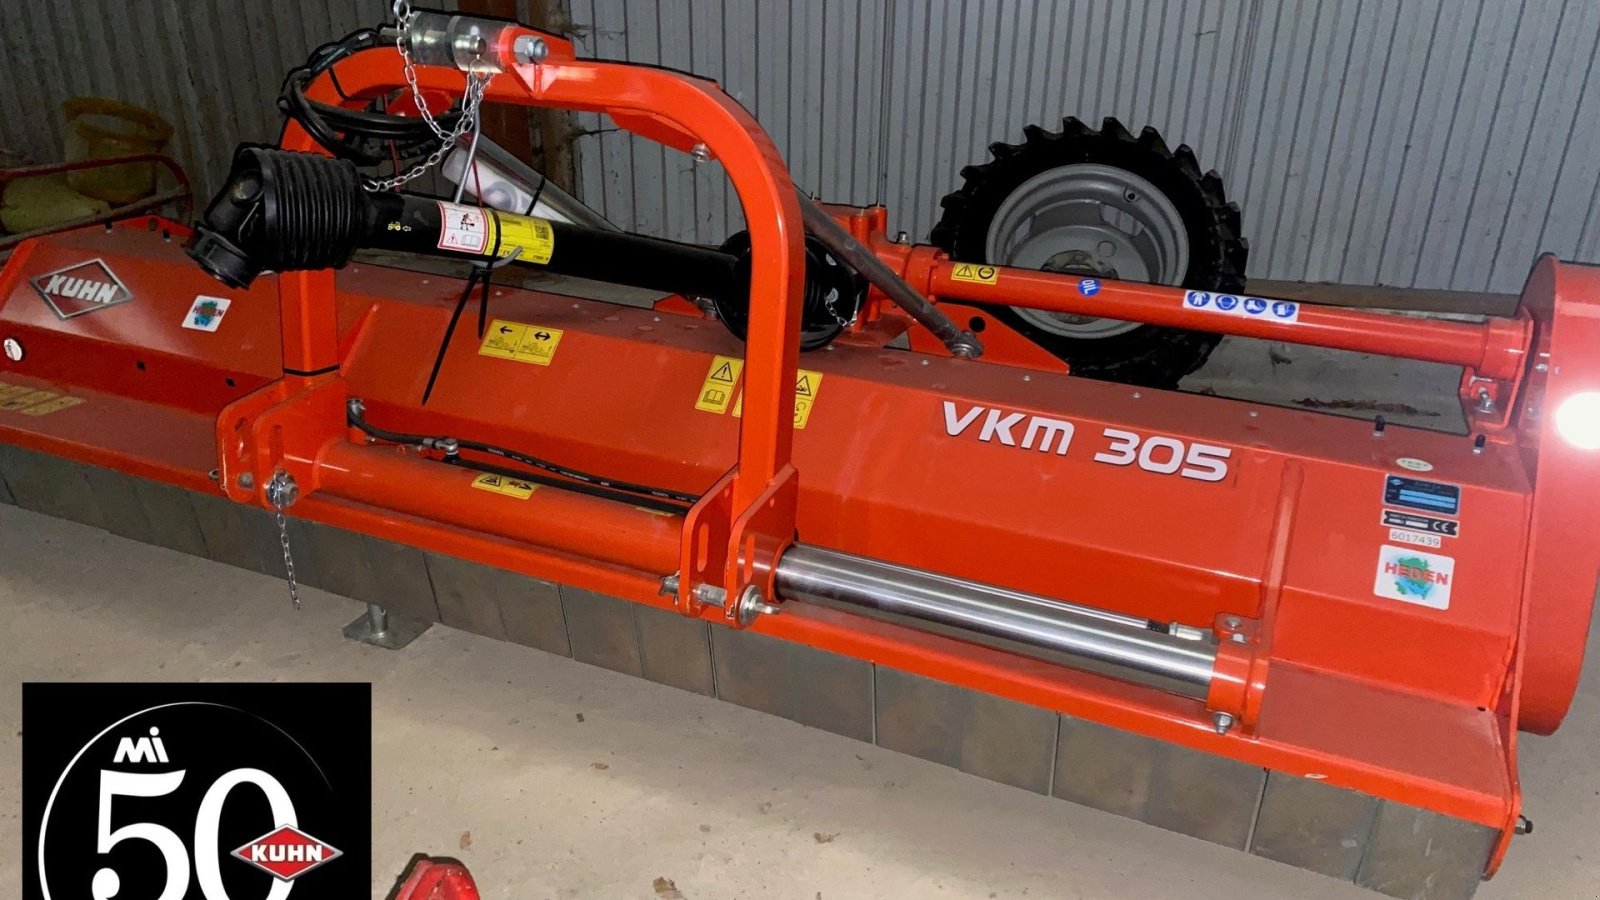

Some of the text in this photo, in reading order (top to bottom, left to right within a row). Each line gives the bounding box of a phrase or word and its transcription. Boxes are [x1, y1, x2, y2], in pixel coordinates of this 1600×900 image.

[44, 274, 119, 304] KUHN
[1082, 279, 1097, 295] OIL
[942, 400, 1232, 482] VKM 305
[1391, 531, 1440, 547] 6017439
[1384, 562, 1449, 586] HEDEN
